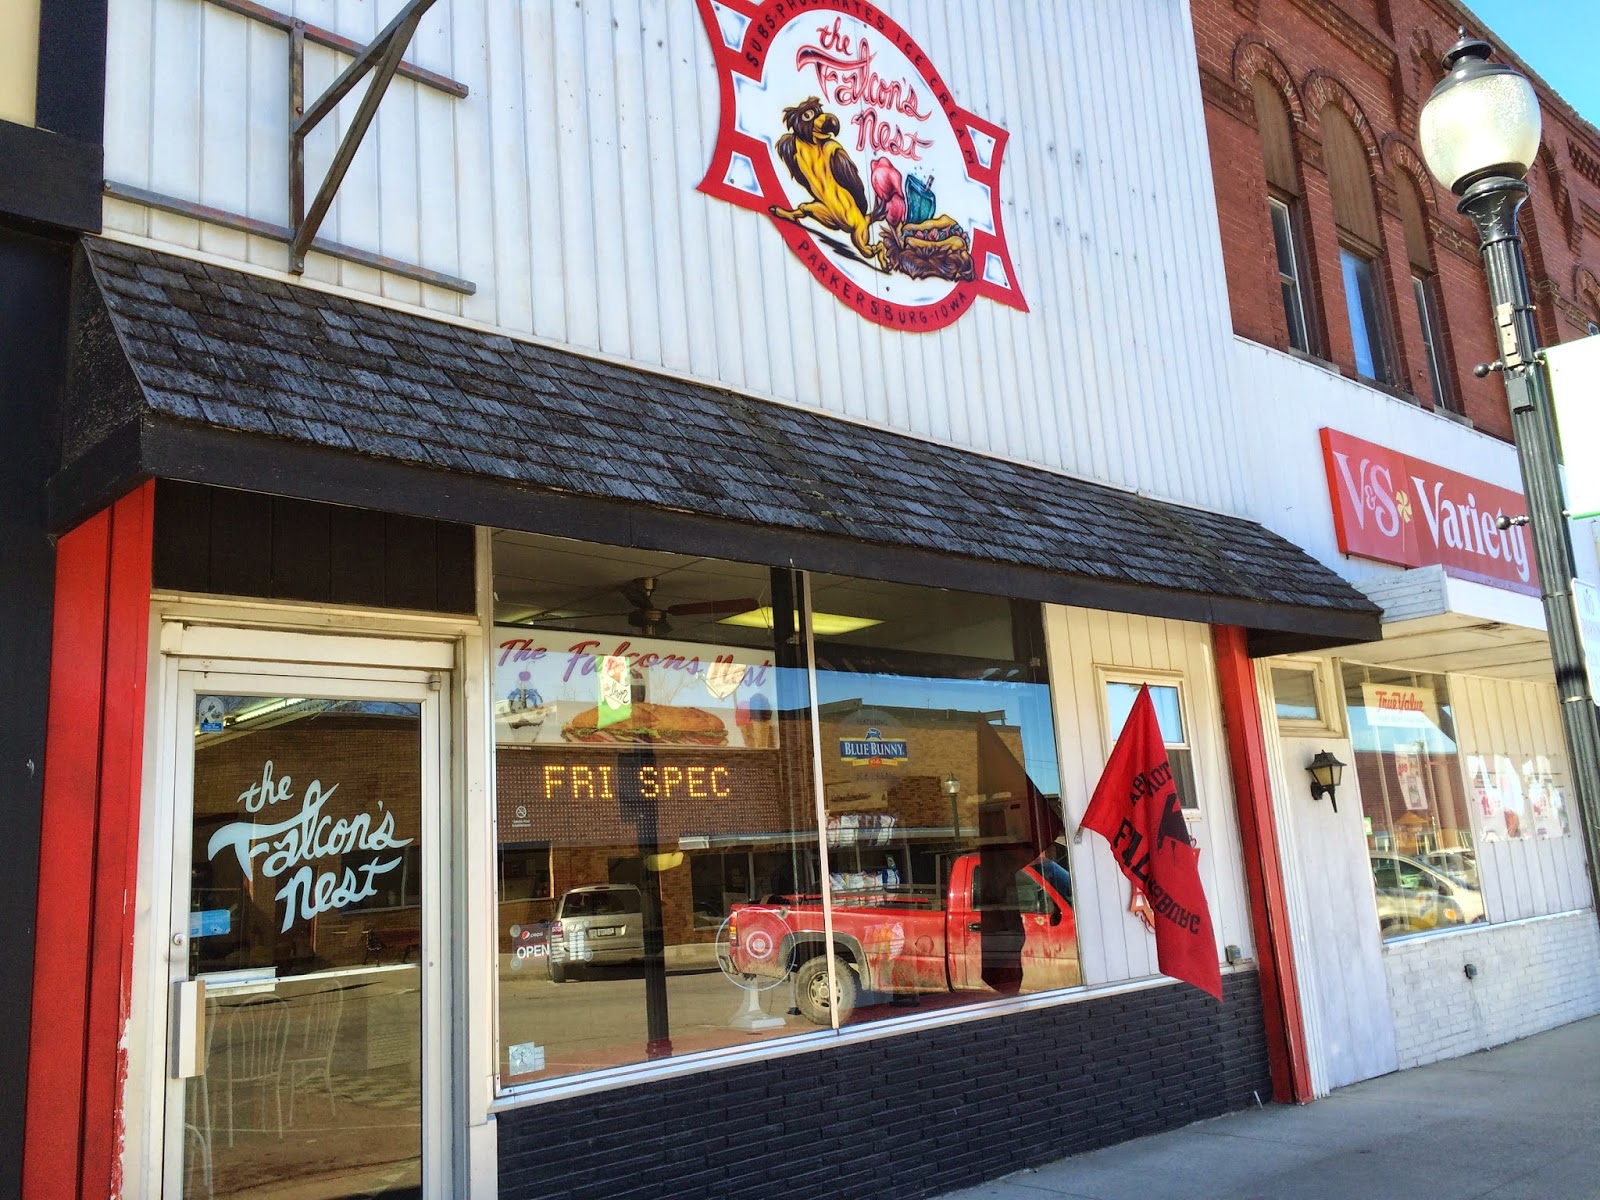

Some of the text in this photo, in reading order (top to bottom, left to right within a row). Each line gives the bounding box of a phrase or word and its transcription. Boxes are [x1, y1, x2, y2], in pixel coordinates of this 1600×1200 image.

[816, 16, 853, 56] the
[776, 0, 885, 30] PHHATES
[896, 32, 923, 66] ICE
[930, 77, 975, 164] CREAM
[796, 37, 932, 121] Falcon's
[1332, 450, 1531, 583] V&S Variety
[498, 639, 547, 667] The
[844, 742, 869, 755] BLUE
[237, 760, 294, 813] the
[544, 765, 731, 799] FRI SPEC
[207, 779, 414, 882] Falcon's
[516, 943, 551, 959] OPEN
